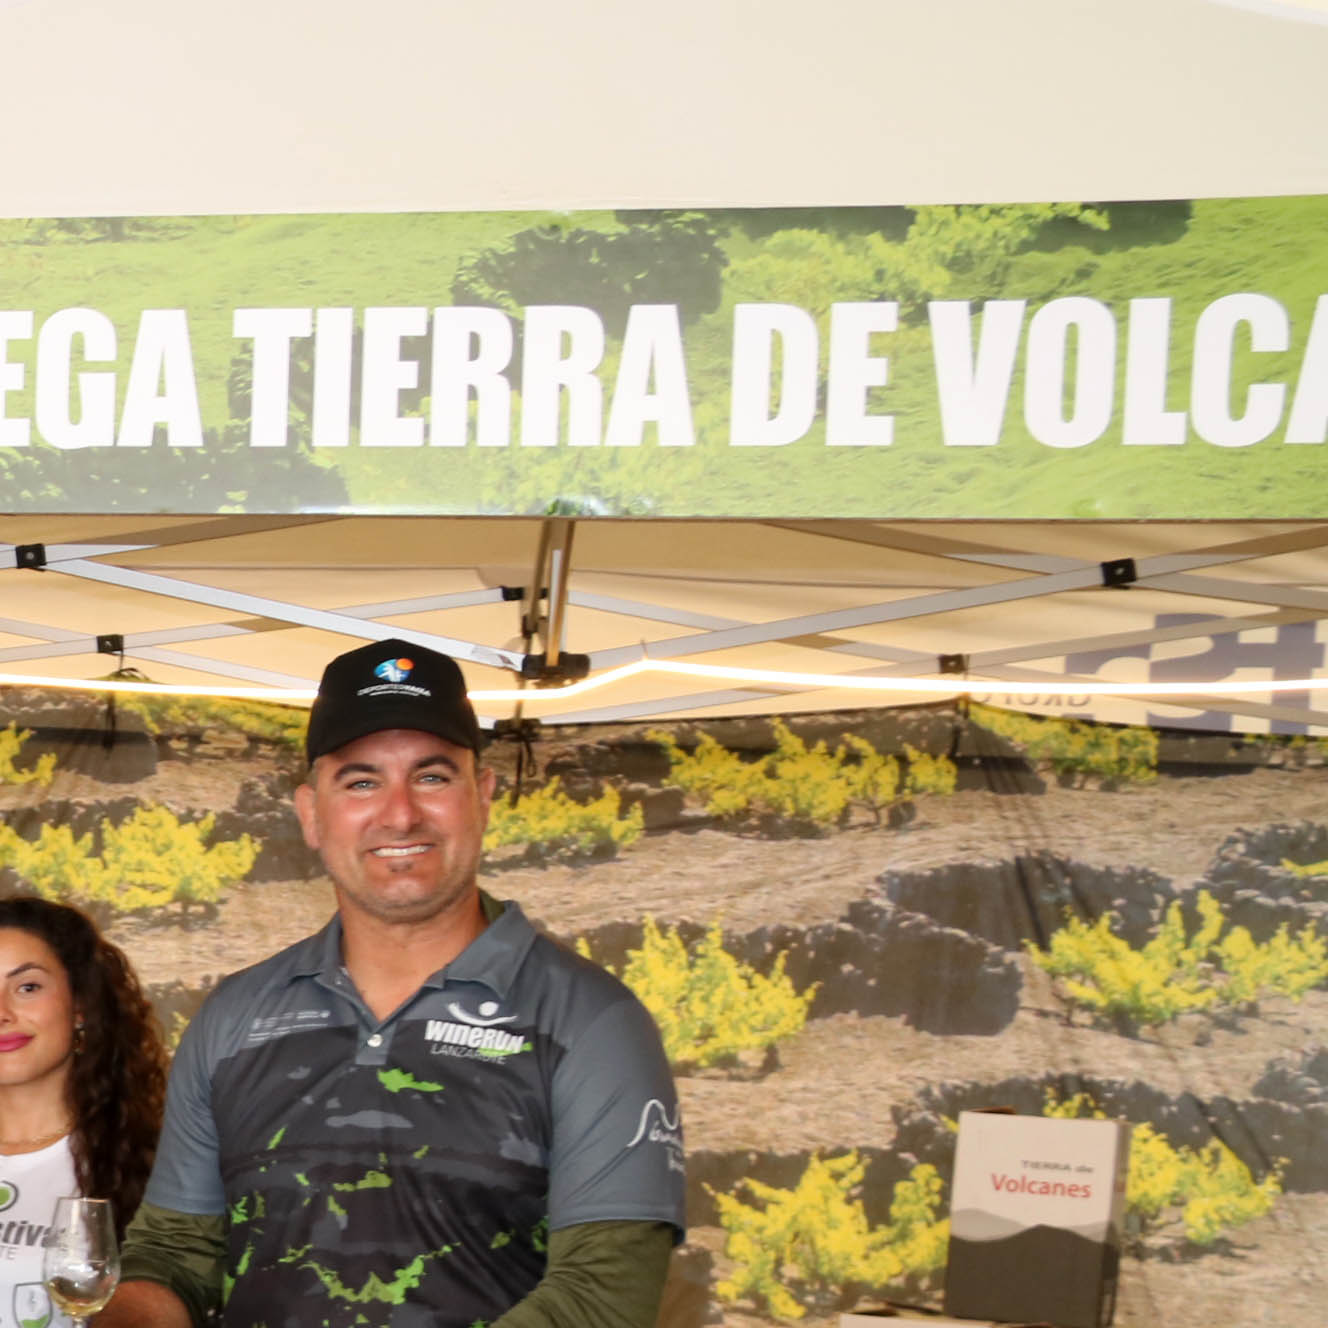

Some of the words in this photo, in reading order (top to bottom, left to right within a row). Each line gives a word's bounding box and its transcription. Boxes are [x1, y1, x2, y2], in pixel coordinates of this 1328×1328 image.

[232, 303, 695, 447] TIERRA
[729, 302, 899, 446] DE
[990, 1173, 1092, 1199] Volcanes
